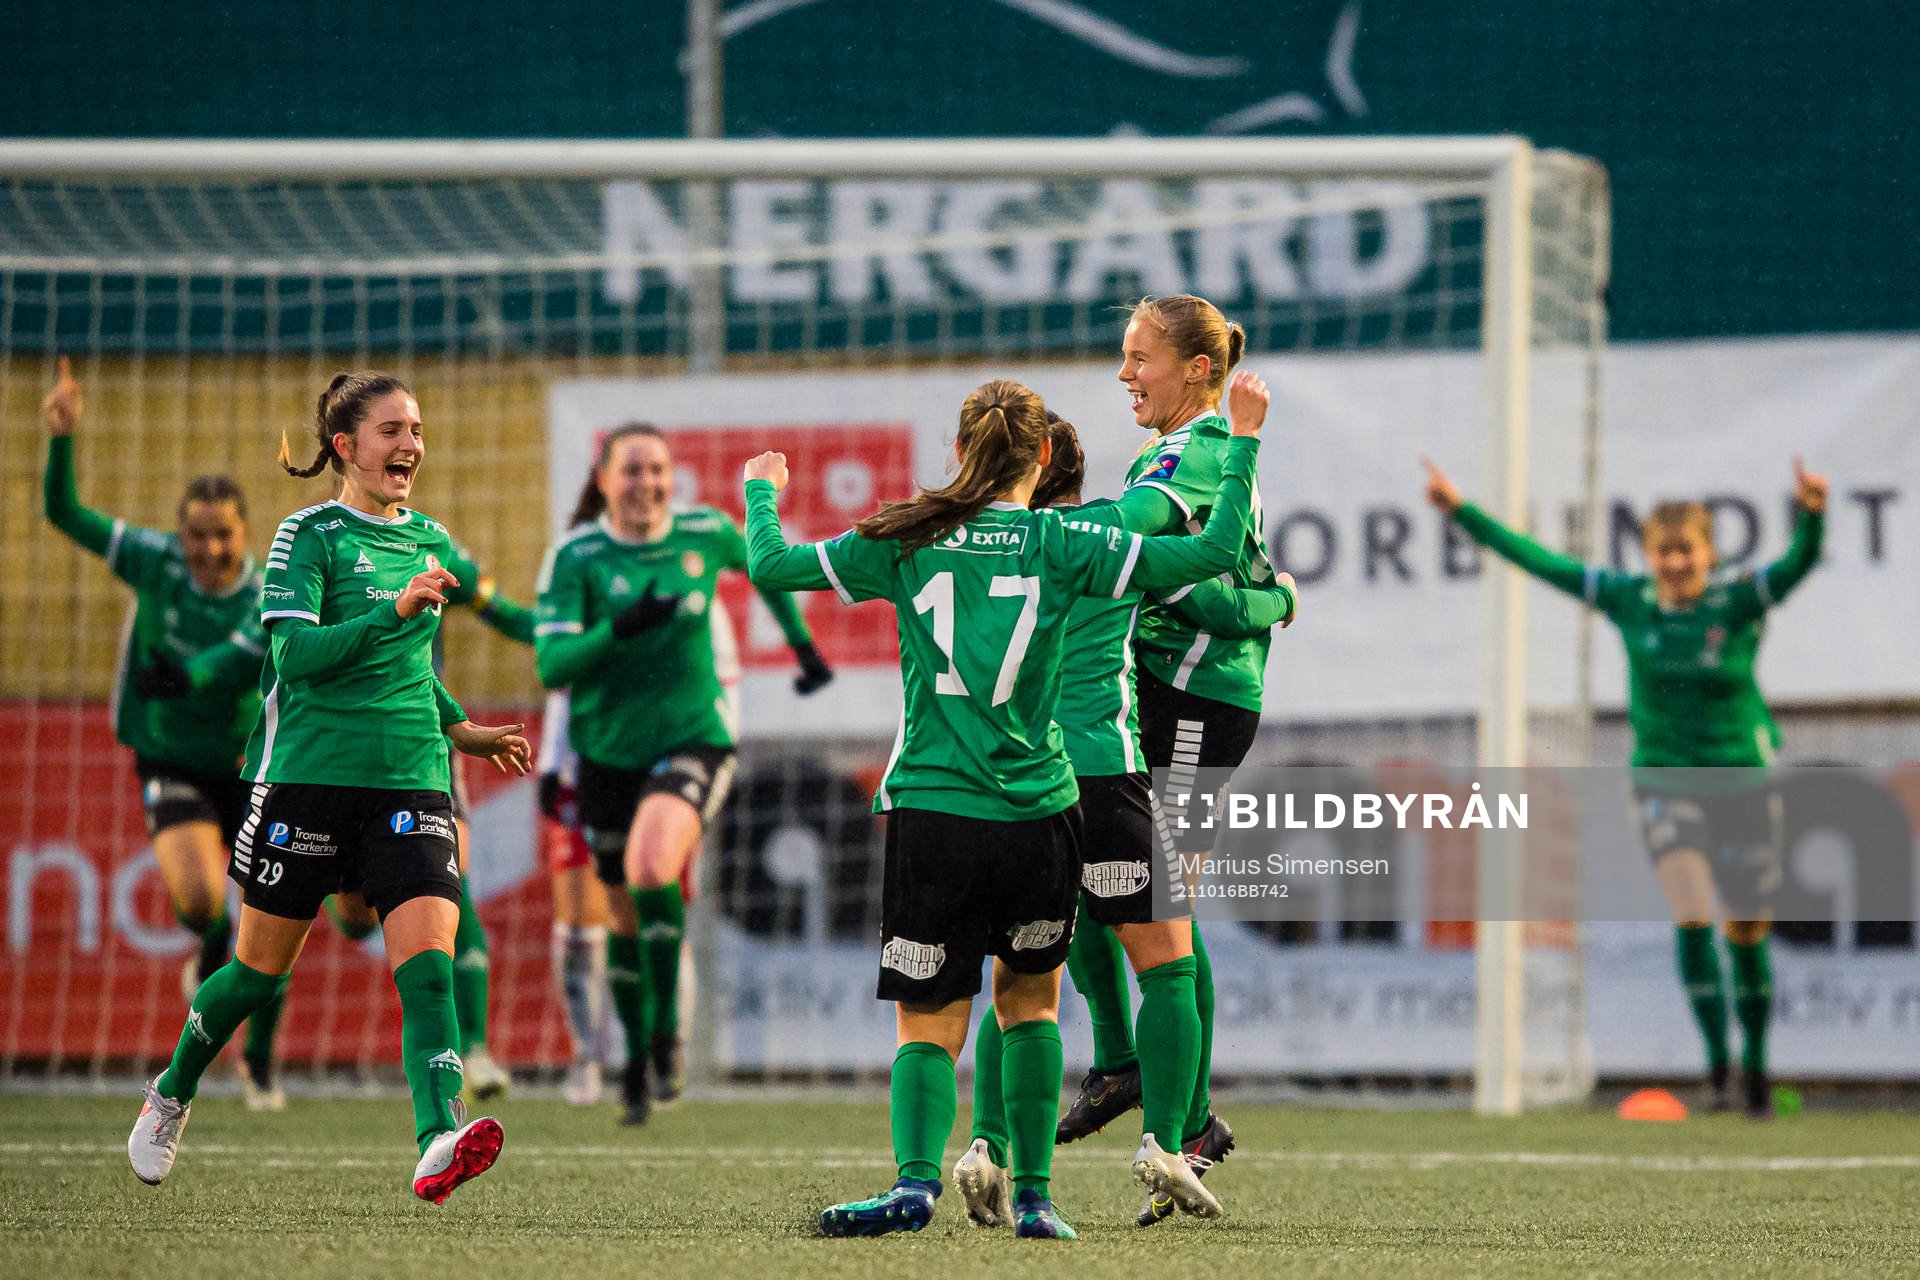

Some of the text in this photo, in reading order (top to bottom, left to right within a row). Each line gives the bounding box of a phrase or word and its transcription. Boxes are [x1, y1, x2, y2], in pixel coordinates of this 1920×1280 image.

[365, 586, 405, 601] Spare
[912, 571, 1040, 708] 17
[417, 811, 449, 827] Tromsø
[294, 827, 331, 842] Tromsø
[291, 841, 338, 856] parkering
[257, 858, 284, 886] 29
